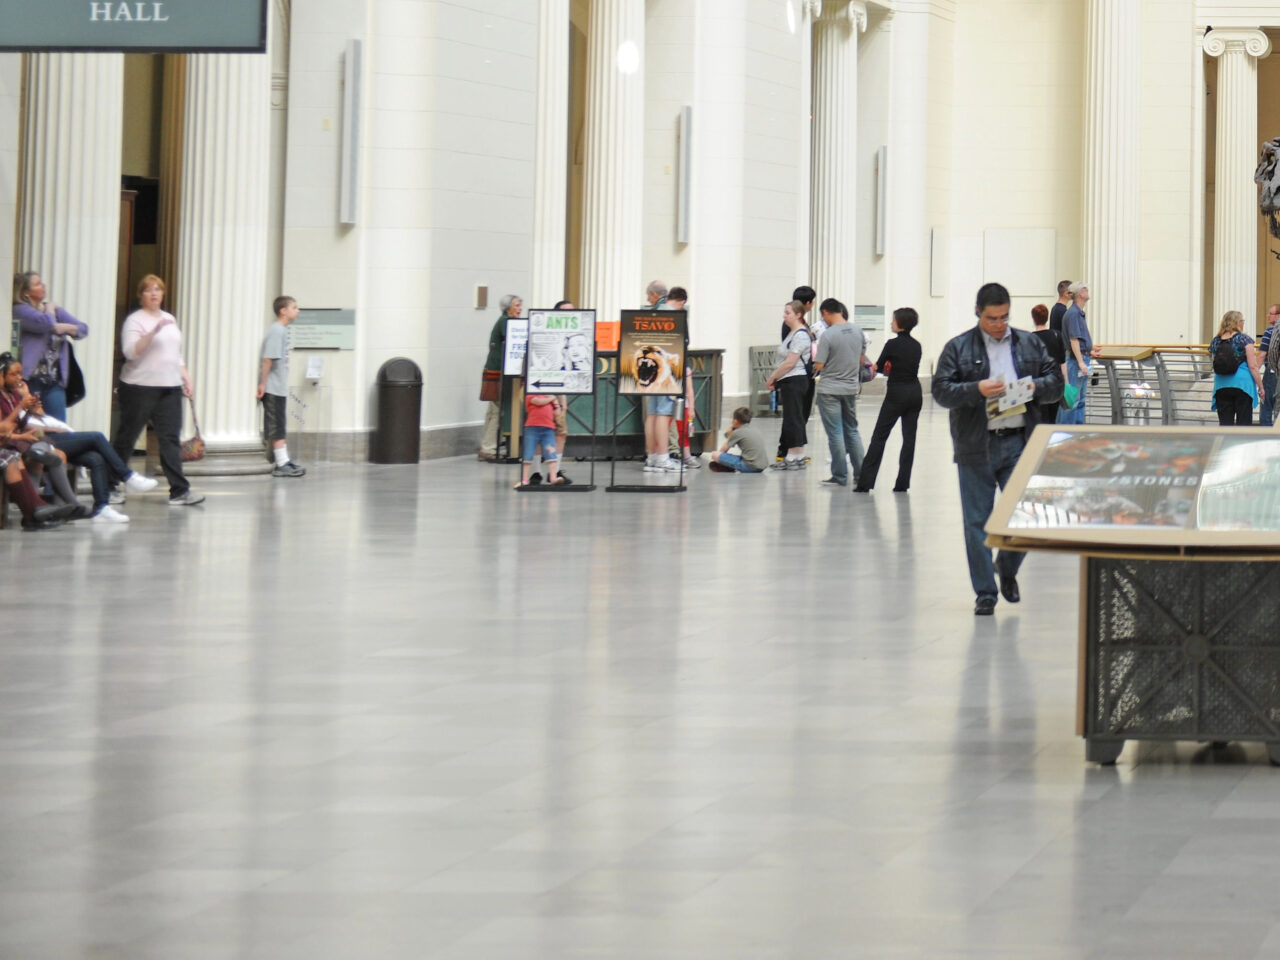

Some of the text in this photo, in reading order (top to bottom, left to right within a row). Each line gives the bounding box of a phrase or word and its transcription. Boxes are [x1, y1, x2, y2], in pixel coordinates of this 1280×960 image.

[90, 1, 169, 21] HALL
[546, 315, 579, 330] ANTS
[633, 320, 676, 332] TSAVO
